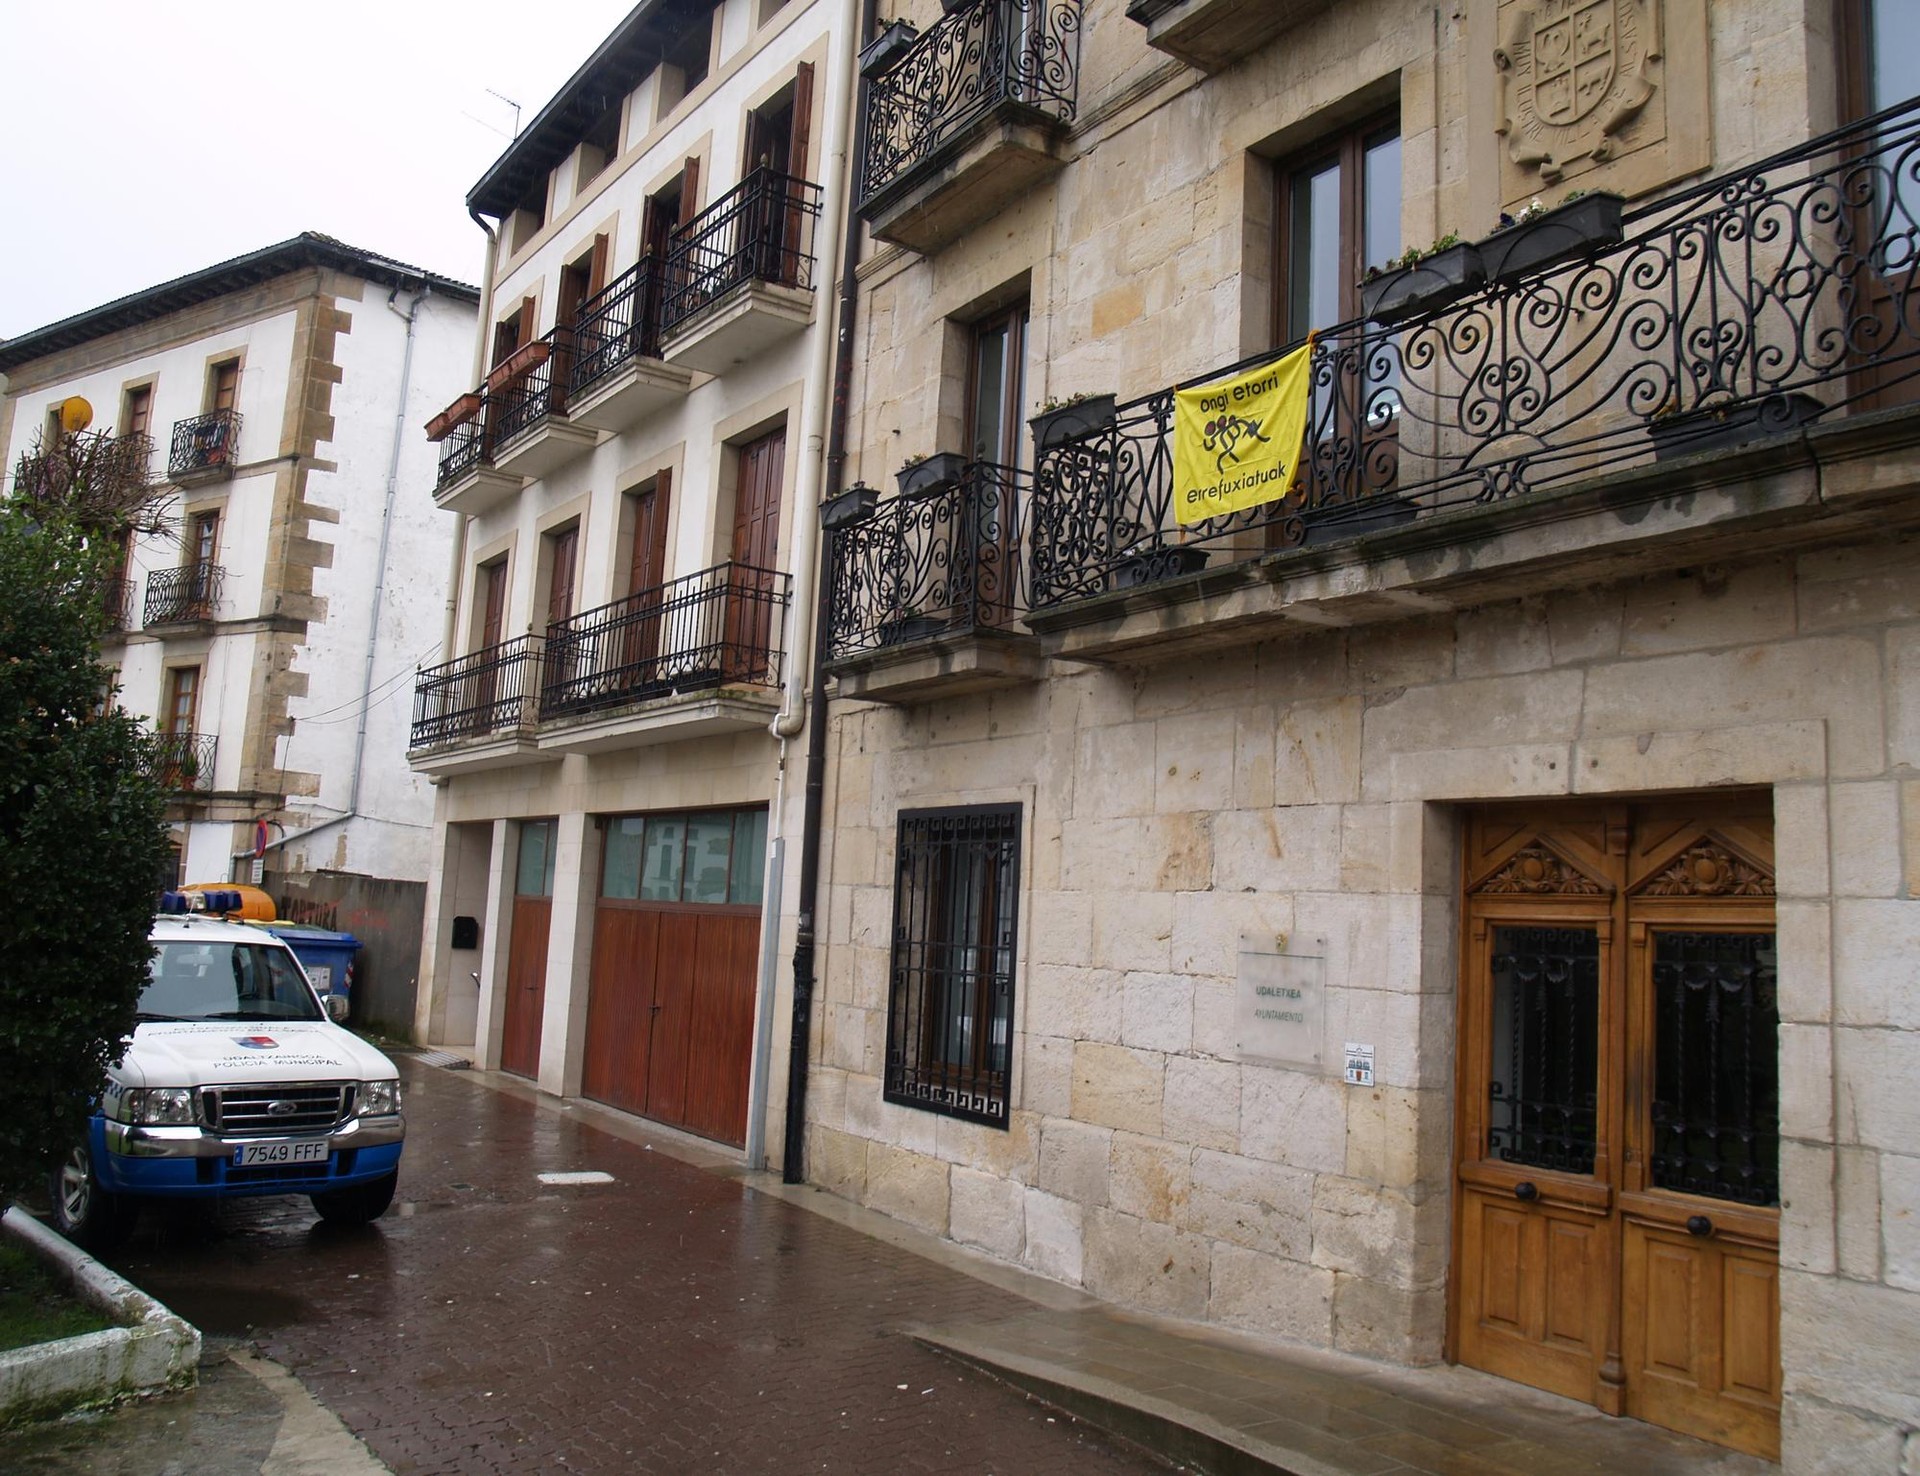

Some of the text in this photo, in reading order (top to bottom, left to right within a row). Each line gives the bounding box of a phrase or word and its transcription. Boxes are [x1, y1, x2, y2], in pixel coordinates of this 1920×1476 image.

[1200, 371, 1279, 413] ongi etorri
[1187, 461, 1286, 503] errefuxiatuak
[1256, 986, 1301, 998] UDALETXEA
[1254, 1009, 1303, 1023] AYUNTAMIENTO
[274, 1059, 343, 1067] MUNICIPAL
[247, 1143, 324, 1163] 7549 FFF
